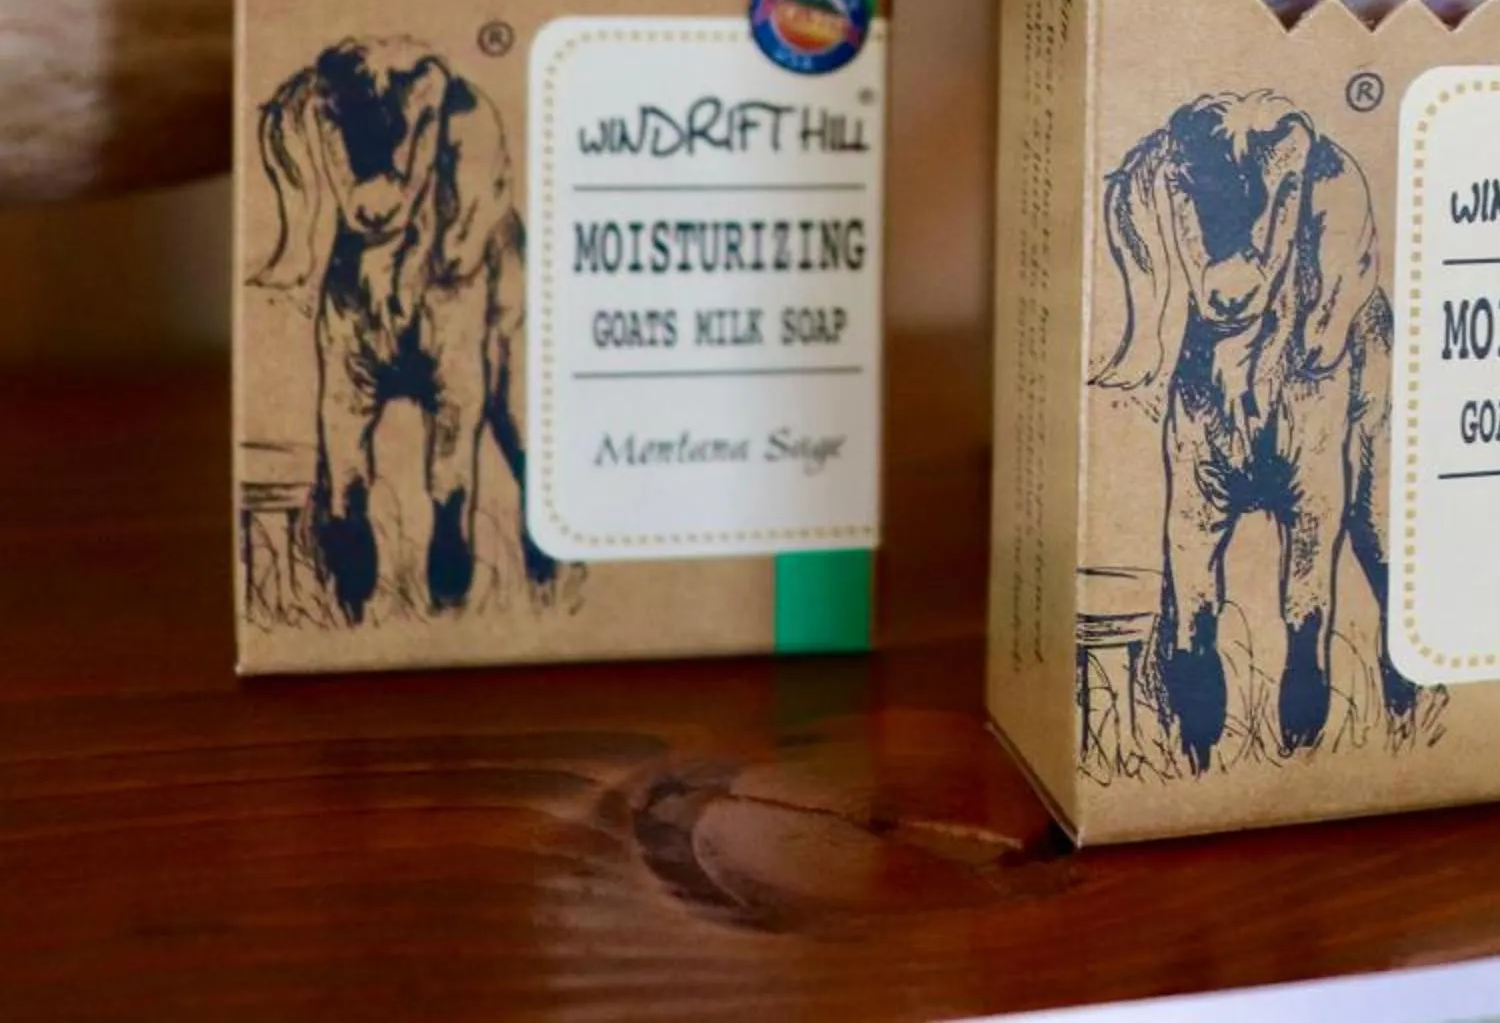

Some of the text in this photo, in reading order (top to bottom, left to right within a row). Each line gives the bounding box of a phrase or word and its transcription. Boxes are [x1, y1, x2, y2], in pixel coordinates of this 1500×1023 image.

[580, 96, 869, 158] WINDRIFT HILL
[573, 219, 866, 274] MOISTURIZING
[592, 306, 848, 348] GOATS MILK SOAP
[593, 430, 750, 466] Montana
